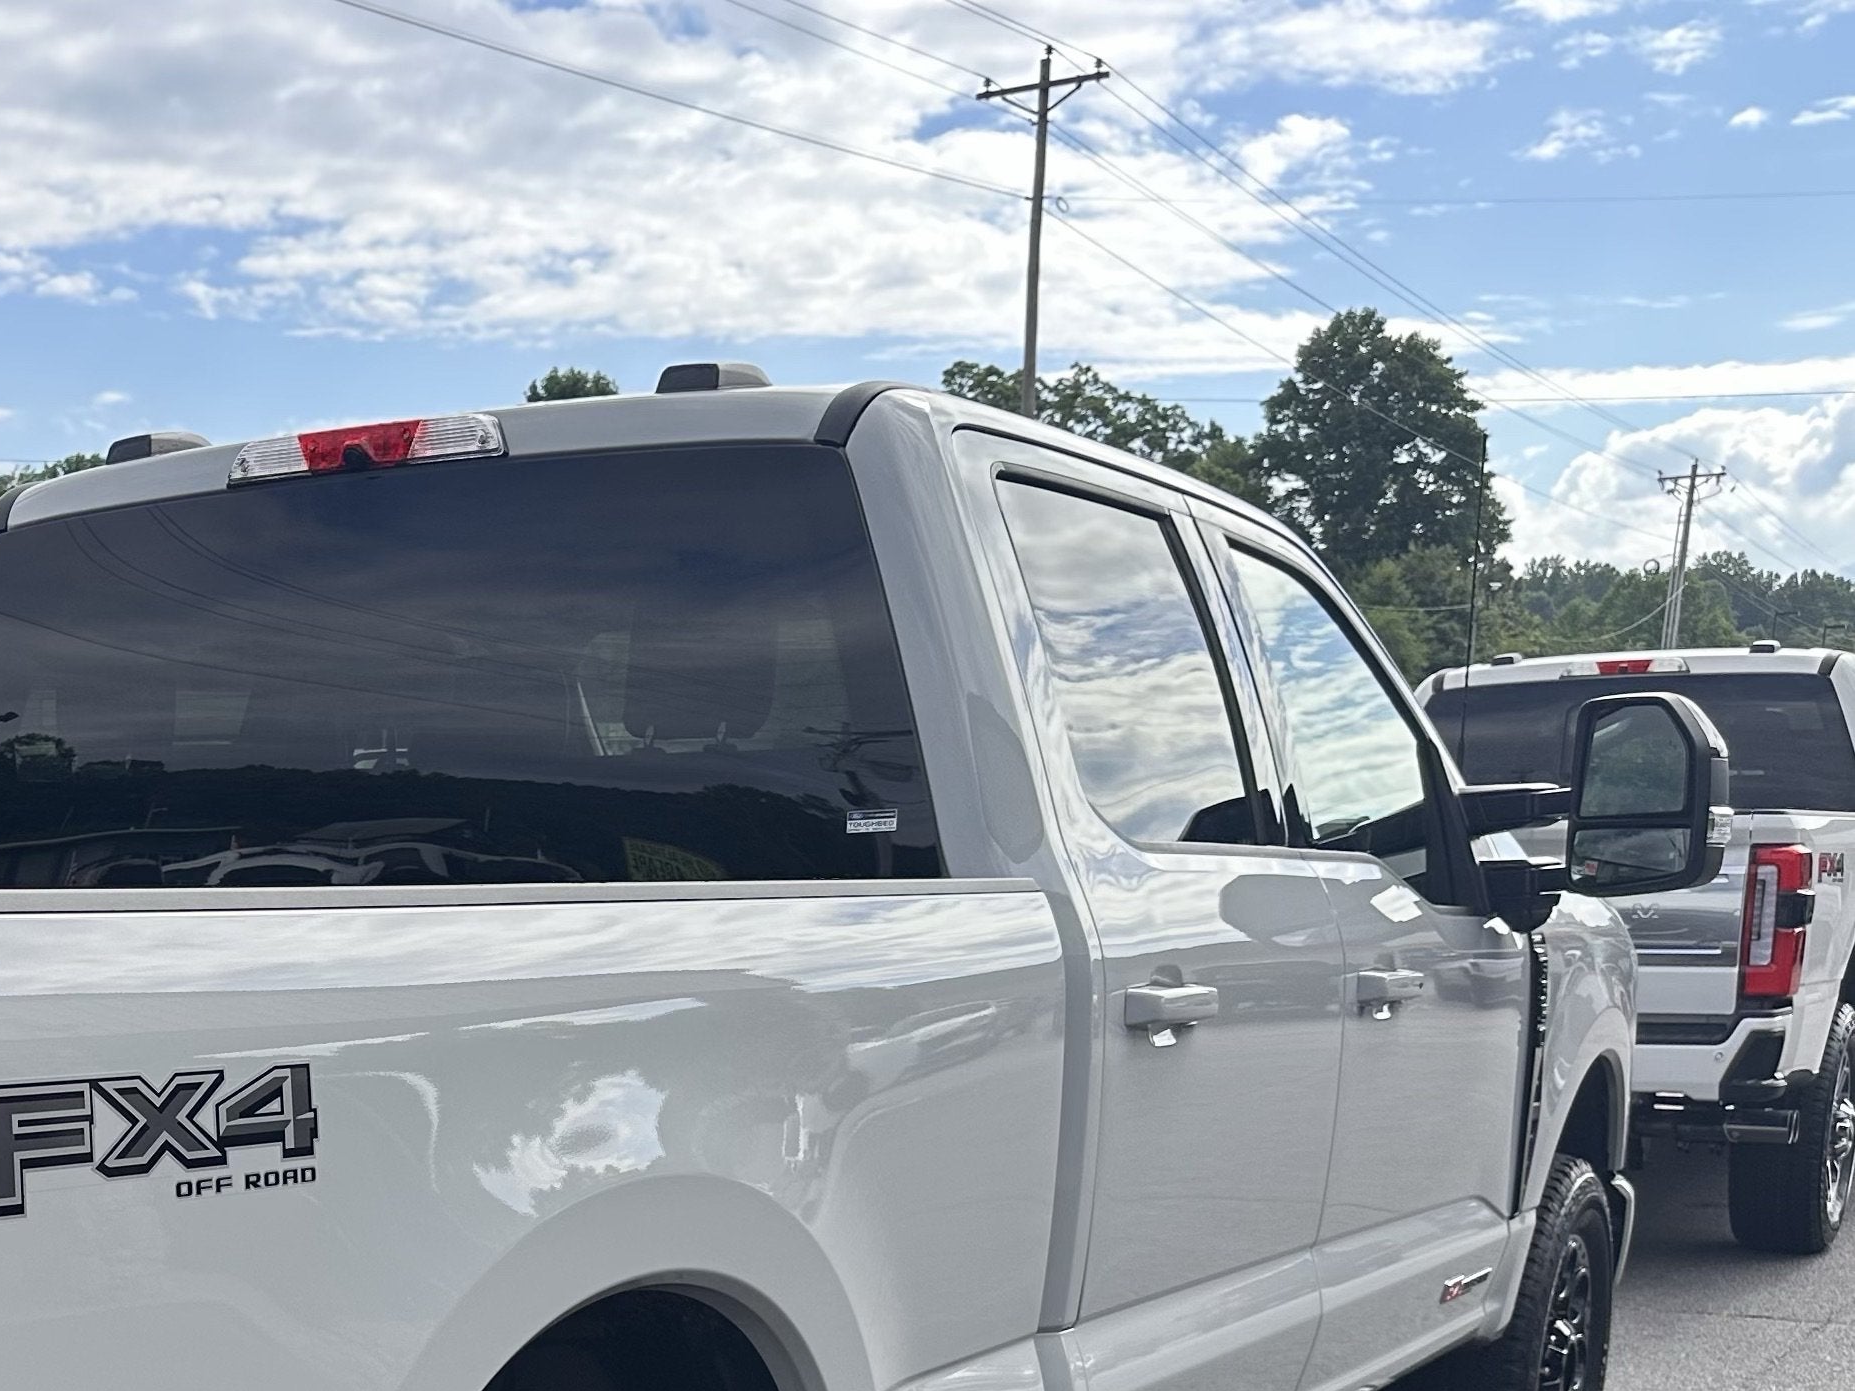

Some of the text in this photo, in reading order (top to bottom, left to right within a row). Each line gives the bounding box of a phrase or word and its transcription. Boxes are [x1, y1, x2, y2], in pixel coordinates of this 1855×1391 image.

[1818, 853, 1844, 882] FX4
[176, 1167, 317, 1198] OFF ROAD
